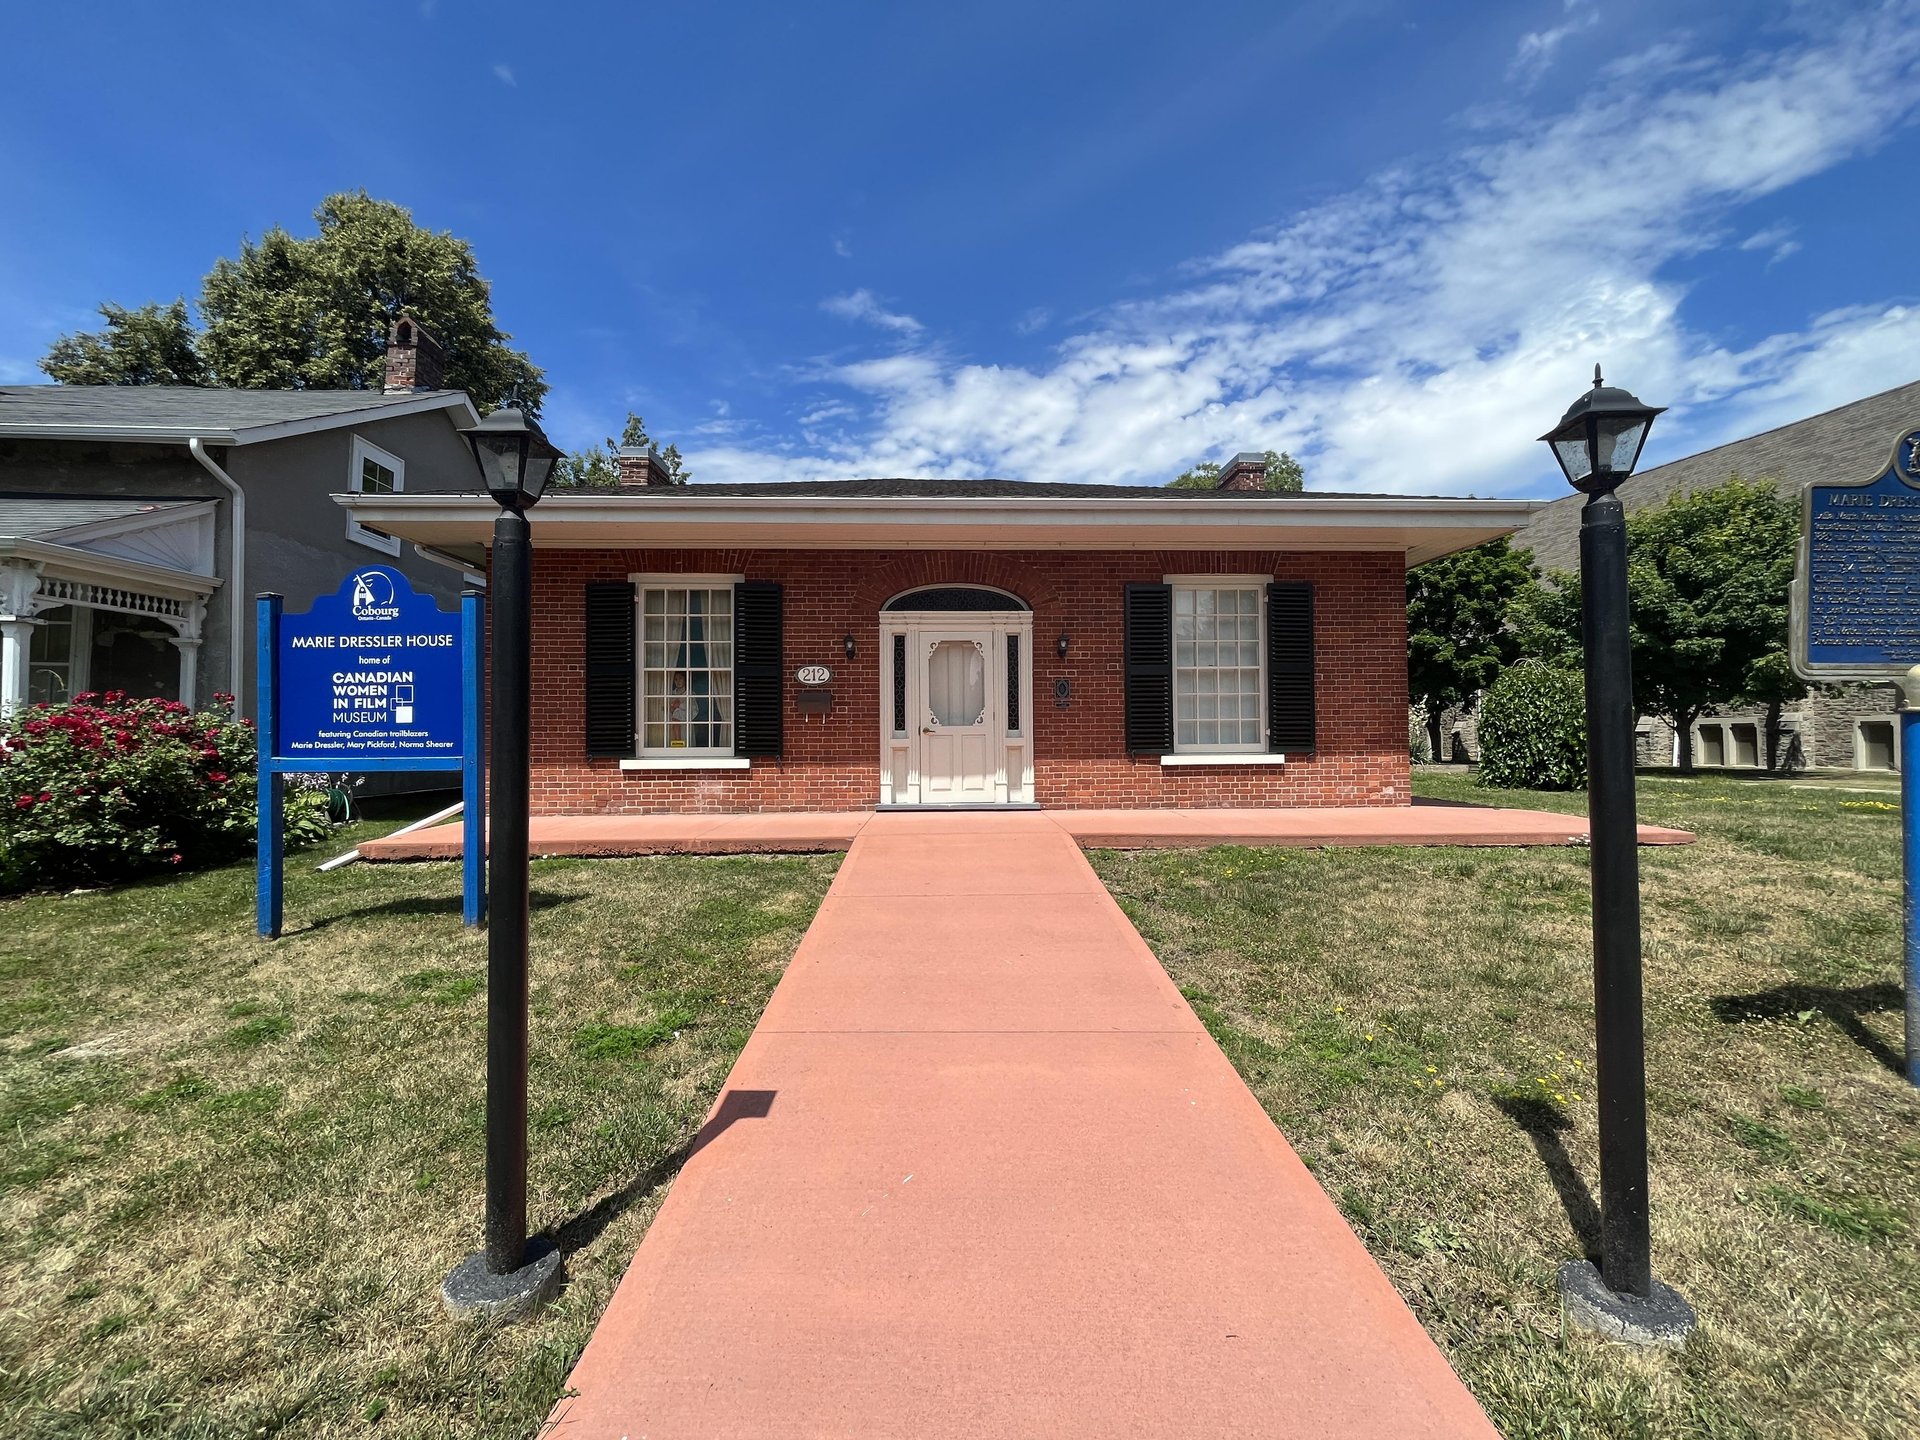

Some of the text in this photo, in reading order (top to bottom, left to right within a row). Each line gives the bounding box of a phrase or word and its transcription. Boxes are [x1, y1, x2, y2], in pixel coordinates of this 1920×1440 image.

[1828, 494, 1873, 506] MARIE
[352, 605, 399, 617] Cobourg
[292, 634, 453, 648] MARIE DRESSLER HOUSE
[358, 655, 391, 664] home of
[332, 671, 413, 684] CANADIAN
[802, 668, 826, 681] 212
[333, 685, 388, 696] WOMEN
[333, 698, 387, 709] IN FILM
[333, 712, 387, 723] MUSEUM
[318, 730, 429, 739] featuring Canadian trailblazers
[346, 741, 365, 749] Mary
[366, 741, 397, 749] Pickford,
